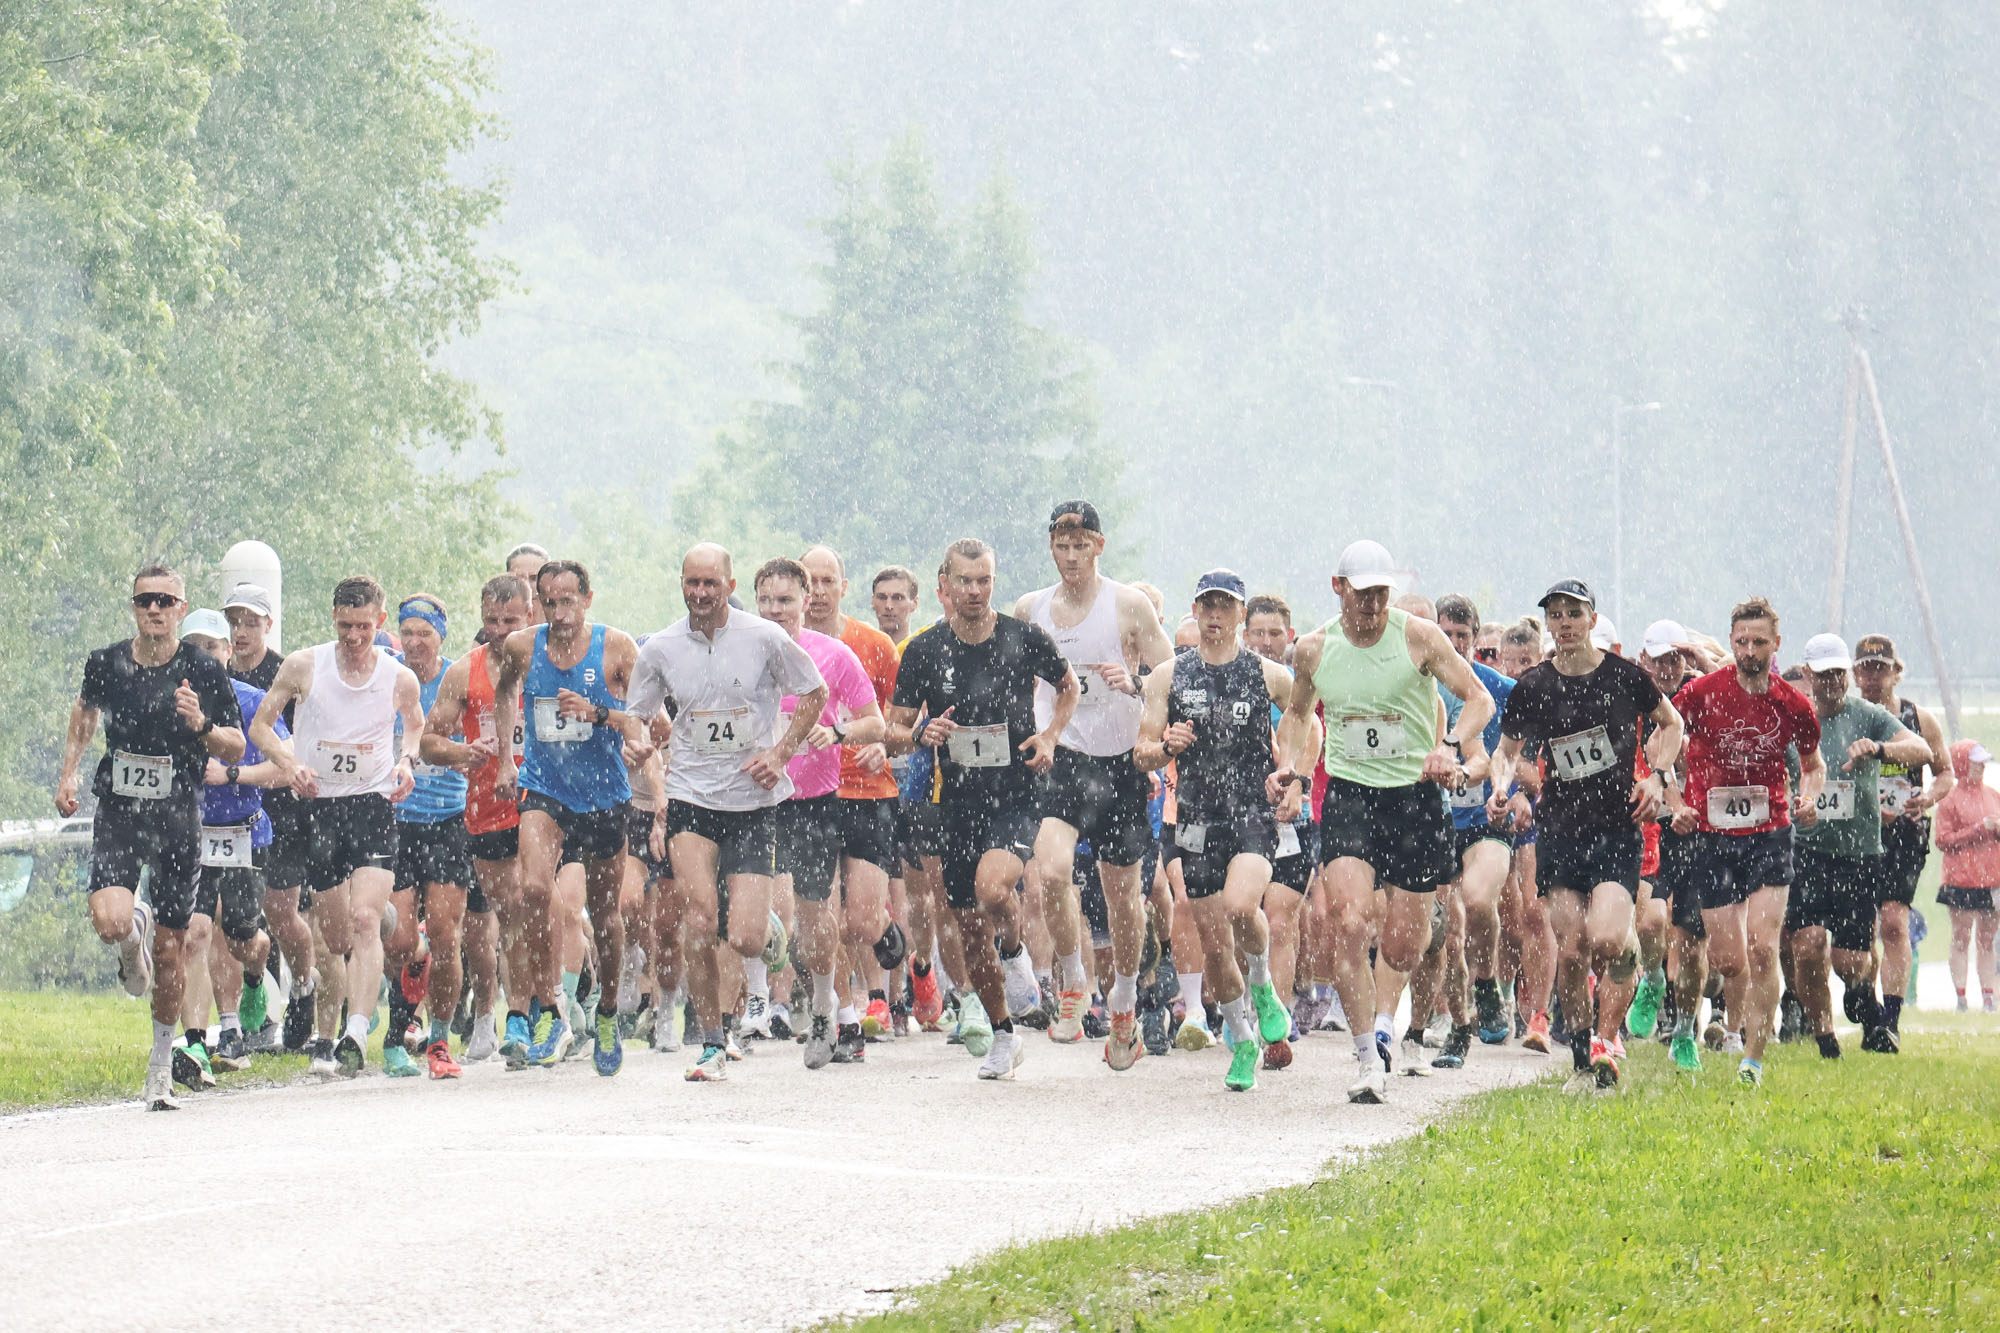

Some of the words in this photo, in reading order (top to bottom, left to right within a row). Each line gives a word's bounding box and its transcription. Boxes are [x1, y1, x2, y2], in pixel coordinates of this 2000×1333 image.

[556, 711, 567, 730] 5
[707, 722, 735, 742] 24
[1366, 728, 1379, 748] 8
[972, 738, 981, 757] 1
[1563, 739, 1603, 769] 116
[332, 753, 357, 774] 25
[122, 766, 160, 788] 125
[1725, 798, 1751, 817] 40
[1816, 792, 1840, 810] 84
[209, 839, 234, 857] 75
